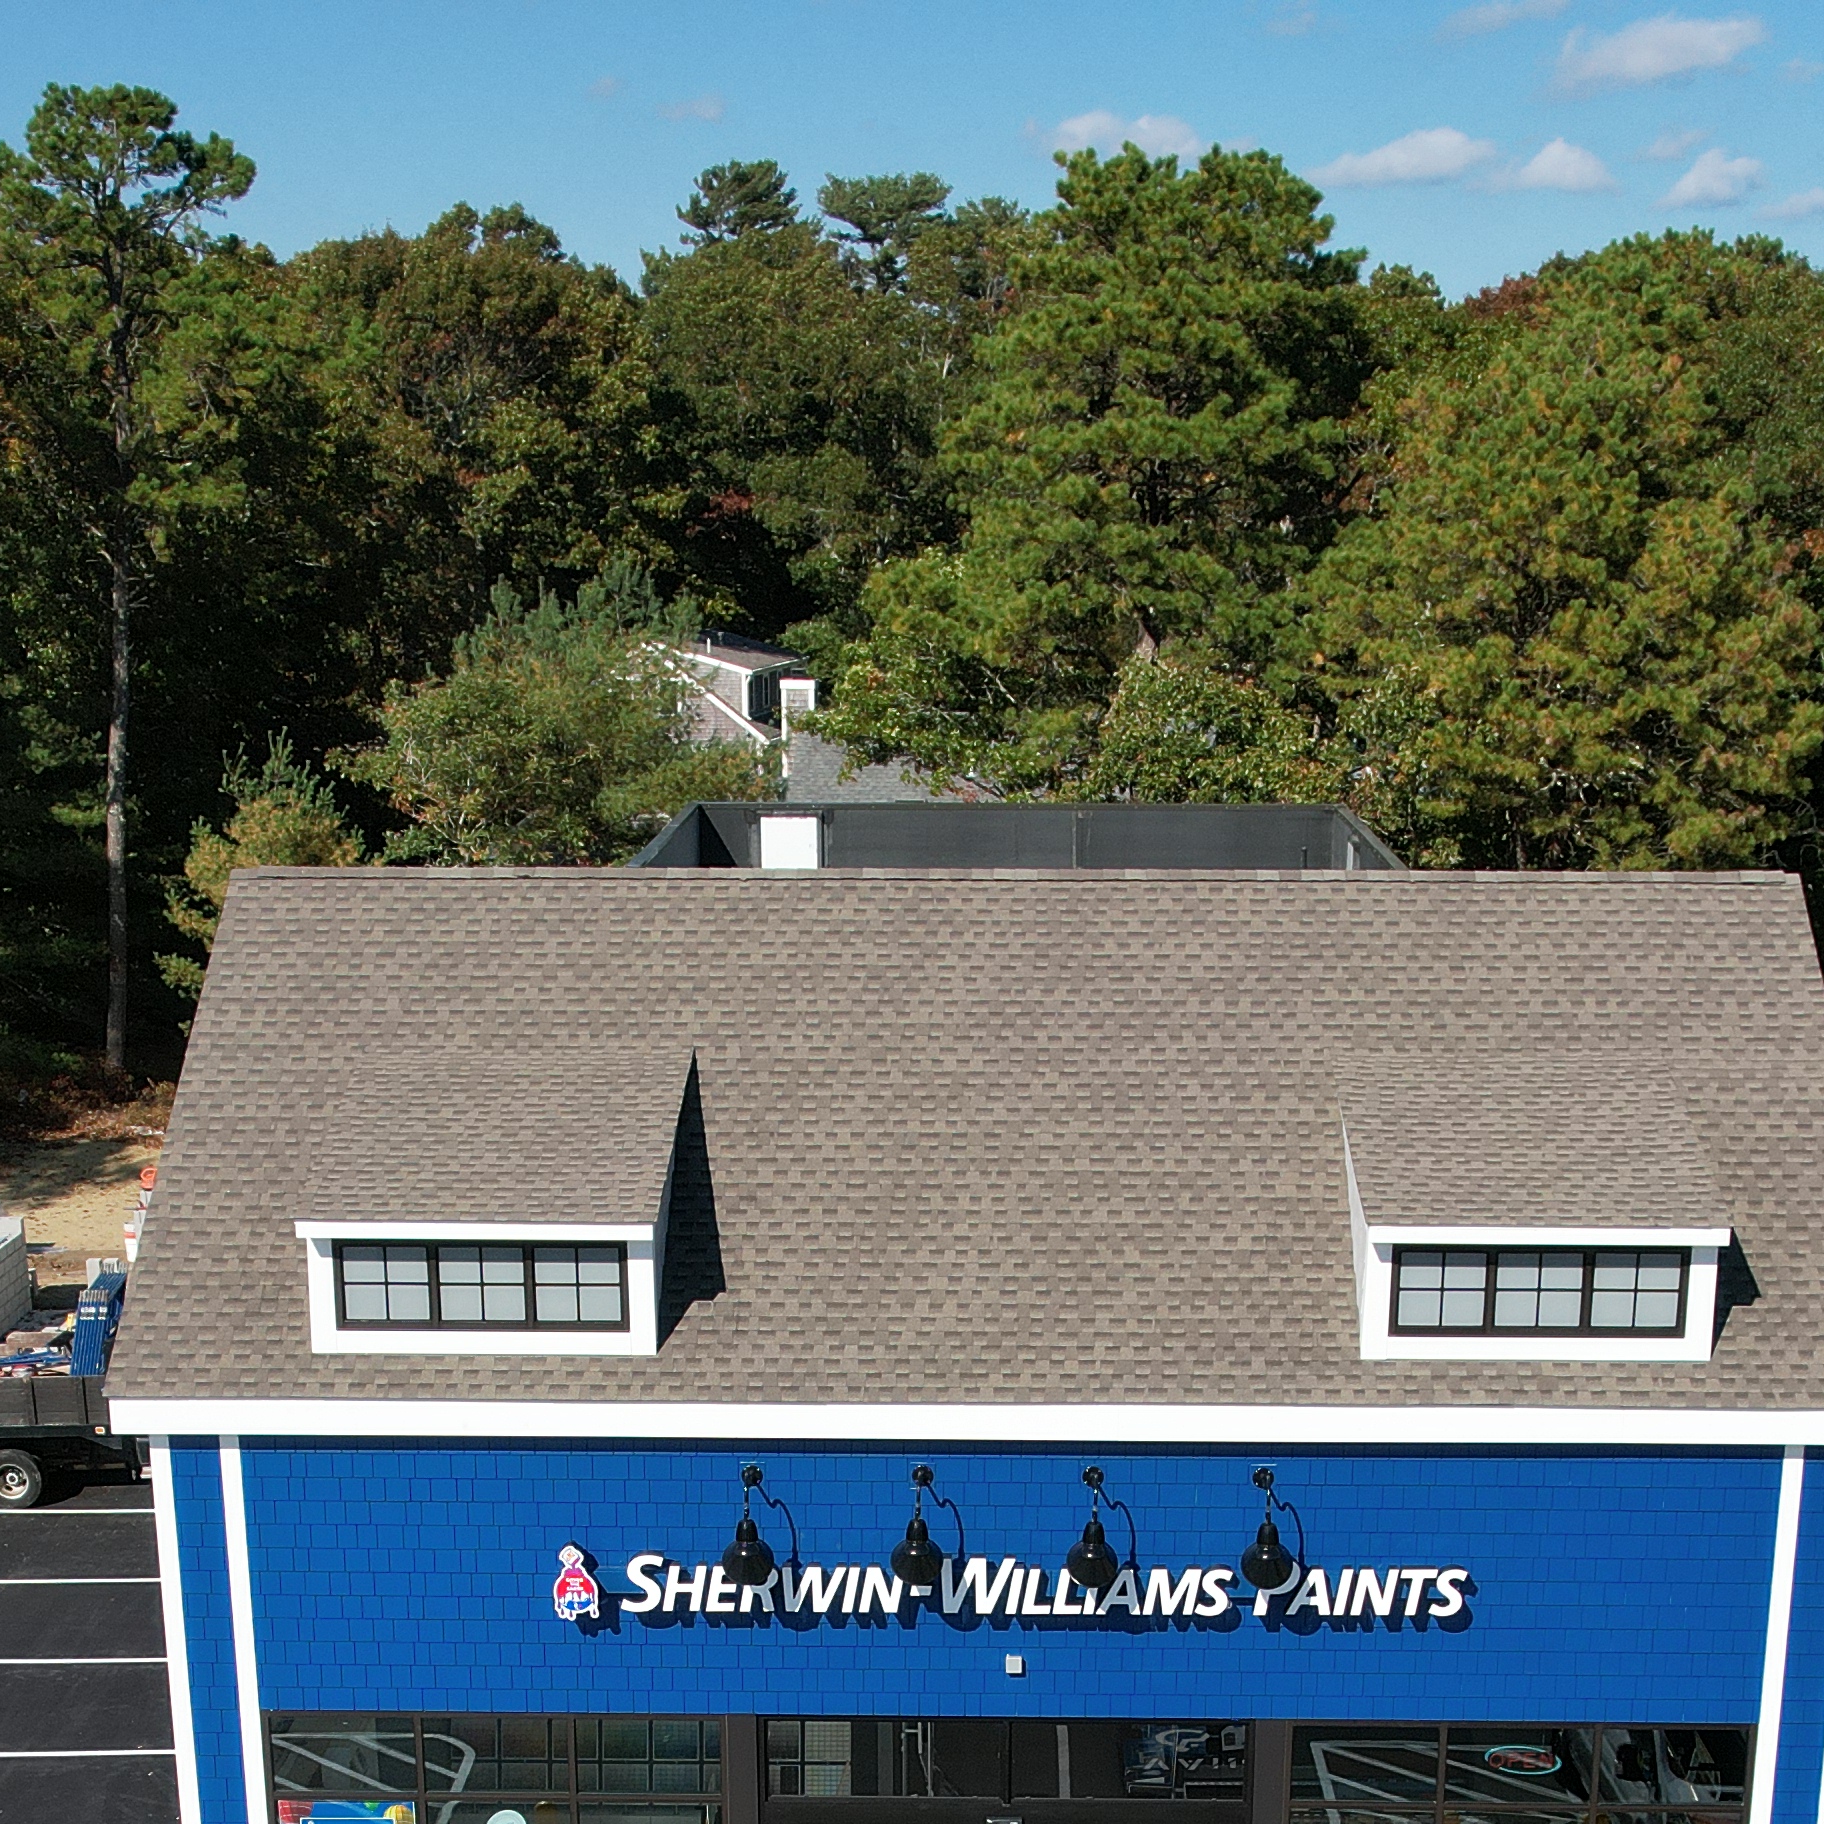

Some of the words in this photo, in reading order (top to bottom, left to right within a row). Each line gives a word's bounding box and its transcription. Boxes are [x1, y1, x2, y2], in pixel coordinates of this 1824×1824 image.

[620, 1554, 1233, 1617] SHERWIN-WILLIAMS
[1252, 1561, 1469, 1617] PAINTS
[1489, 1752, 1555, 1769] OPEN
